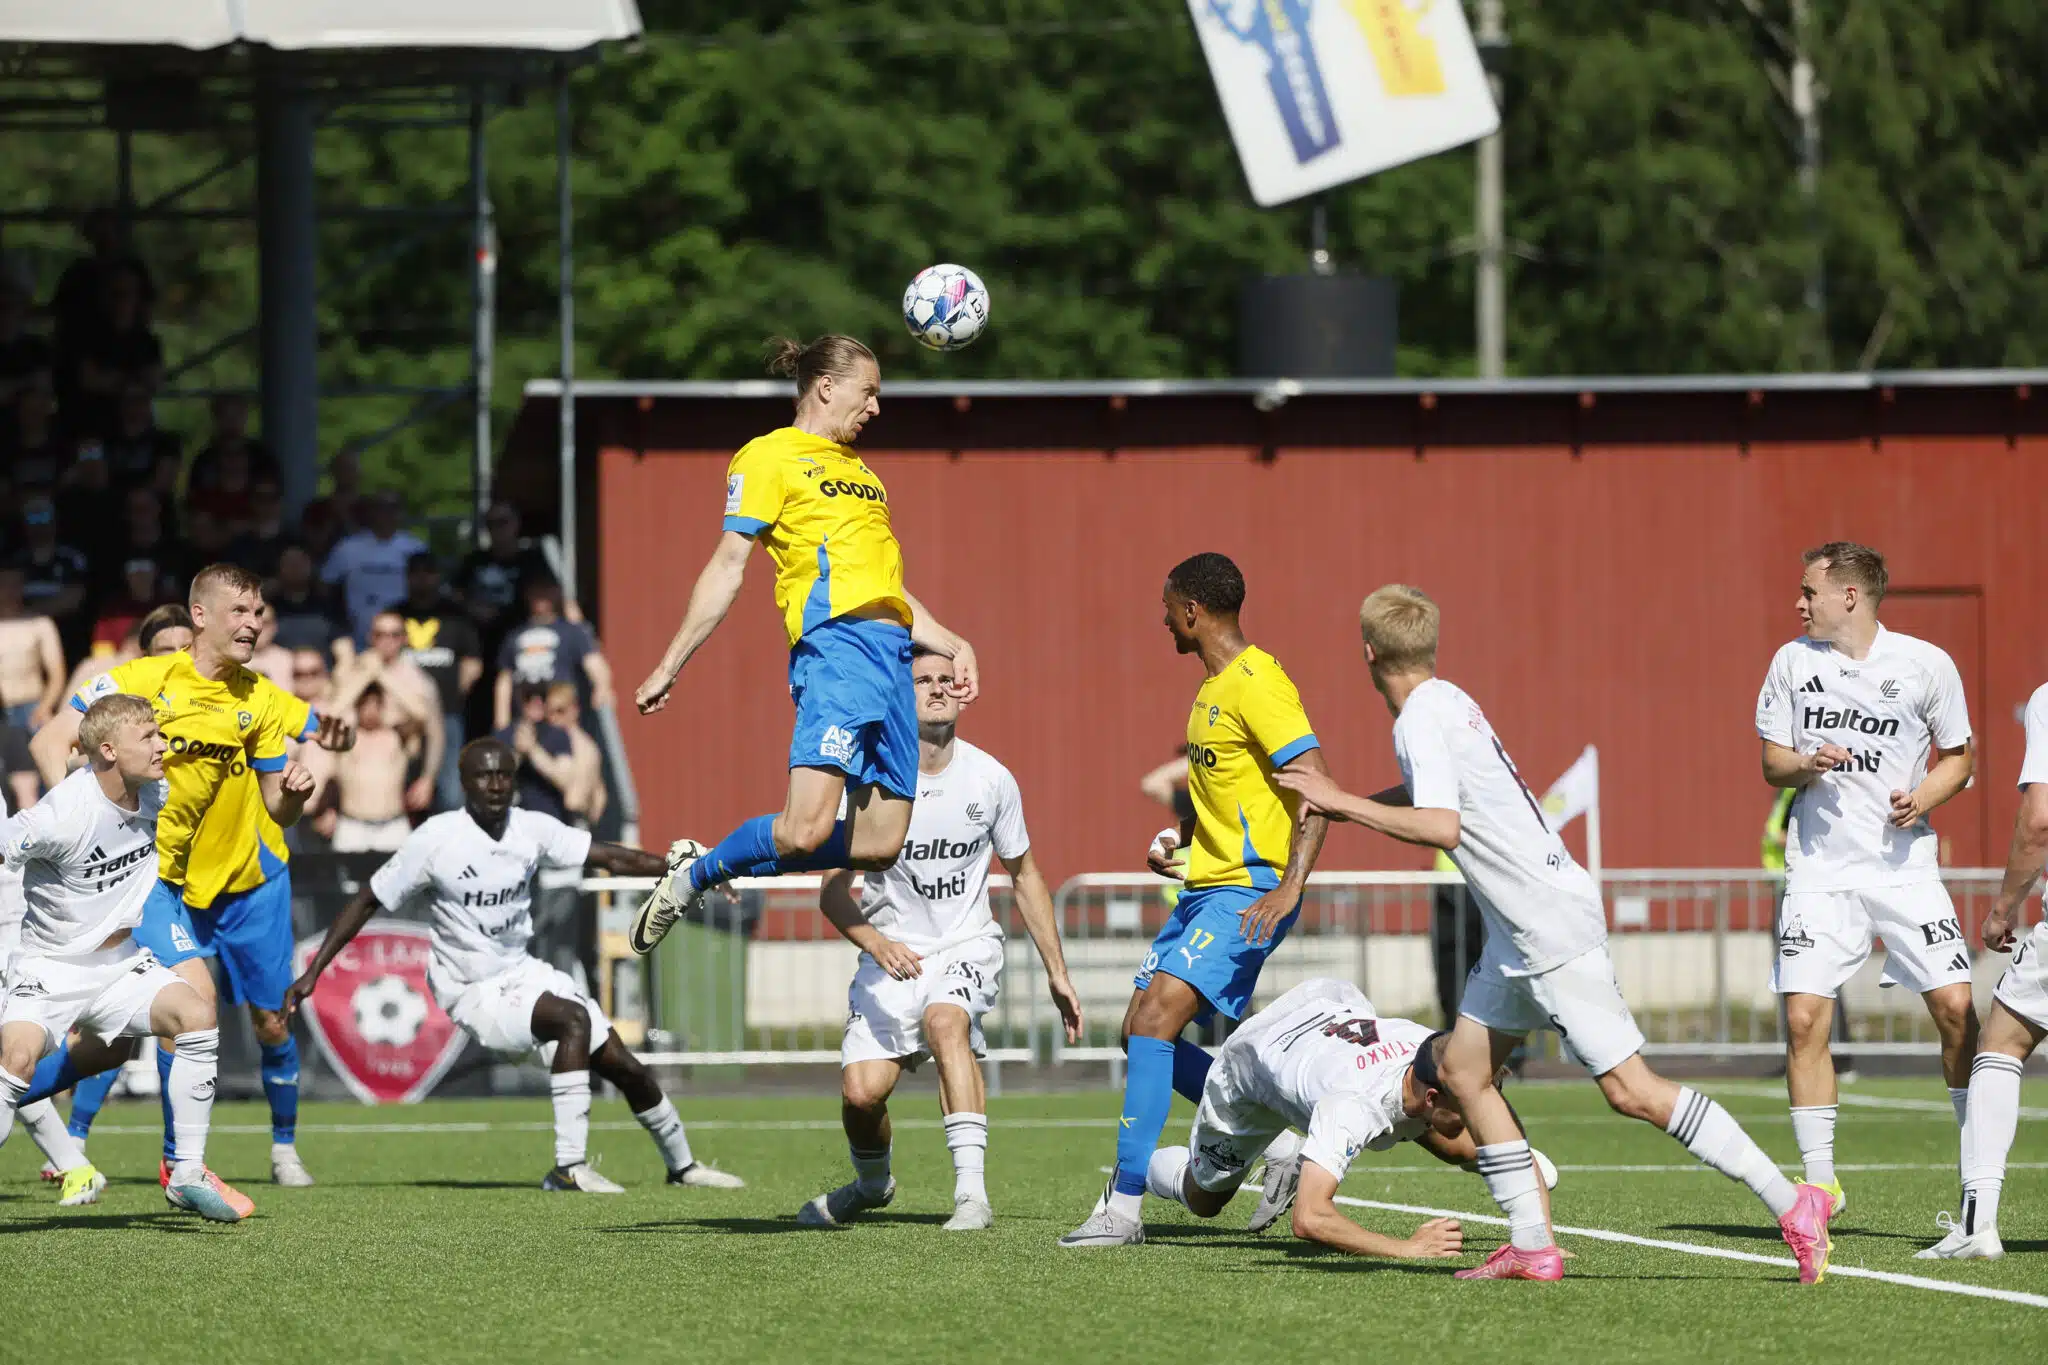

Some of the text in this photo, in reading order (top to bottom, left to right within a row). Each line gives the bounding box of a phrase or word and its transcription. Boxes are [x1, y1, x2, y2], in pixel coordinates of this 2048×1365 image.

[819, 480, 886, 503] GOODI
[1803, 706, 1900, 737] Halton
[158, 731, 233, 763] OODIO
[912, 871, 966, 900] Lahti
[1189, 928, 1216, 950] 17
[945, 960, 985, 990] ESS
